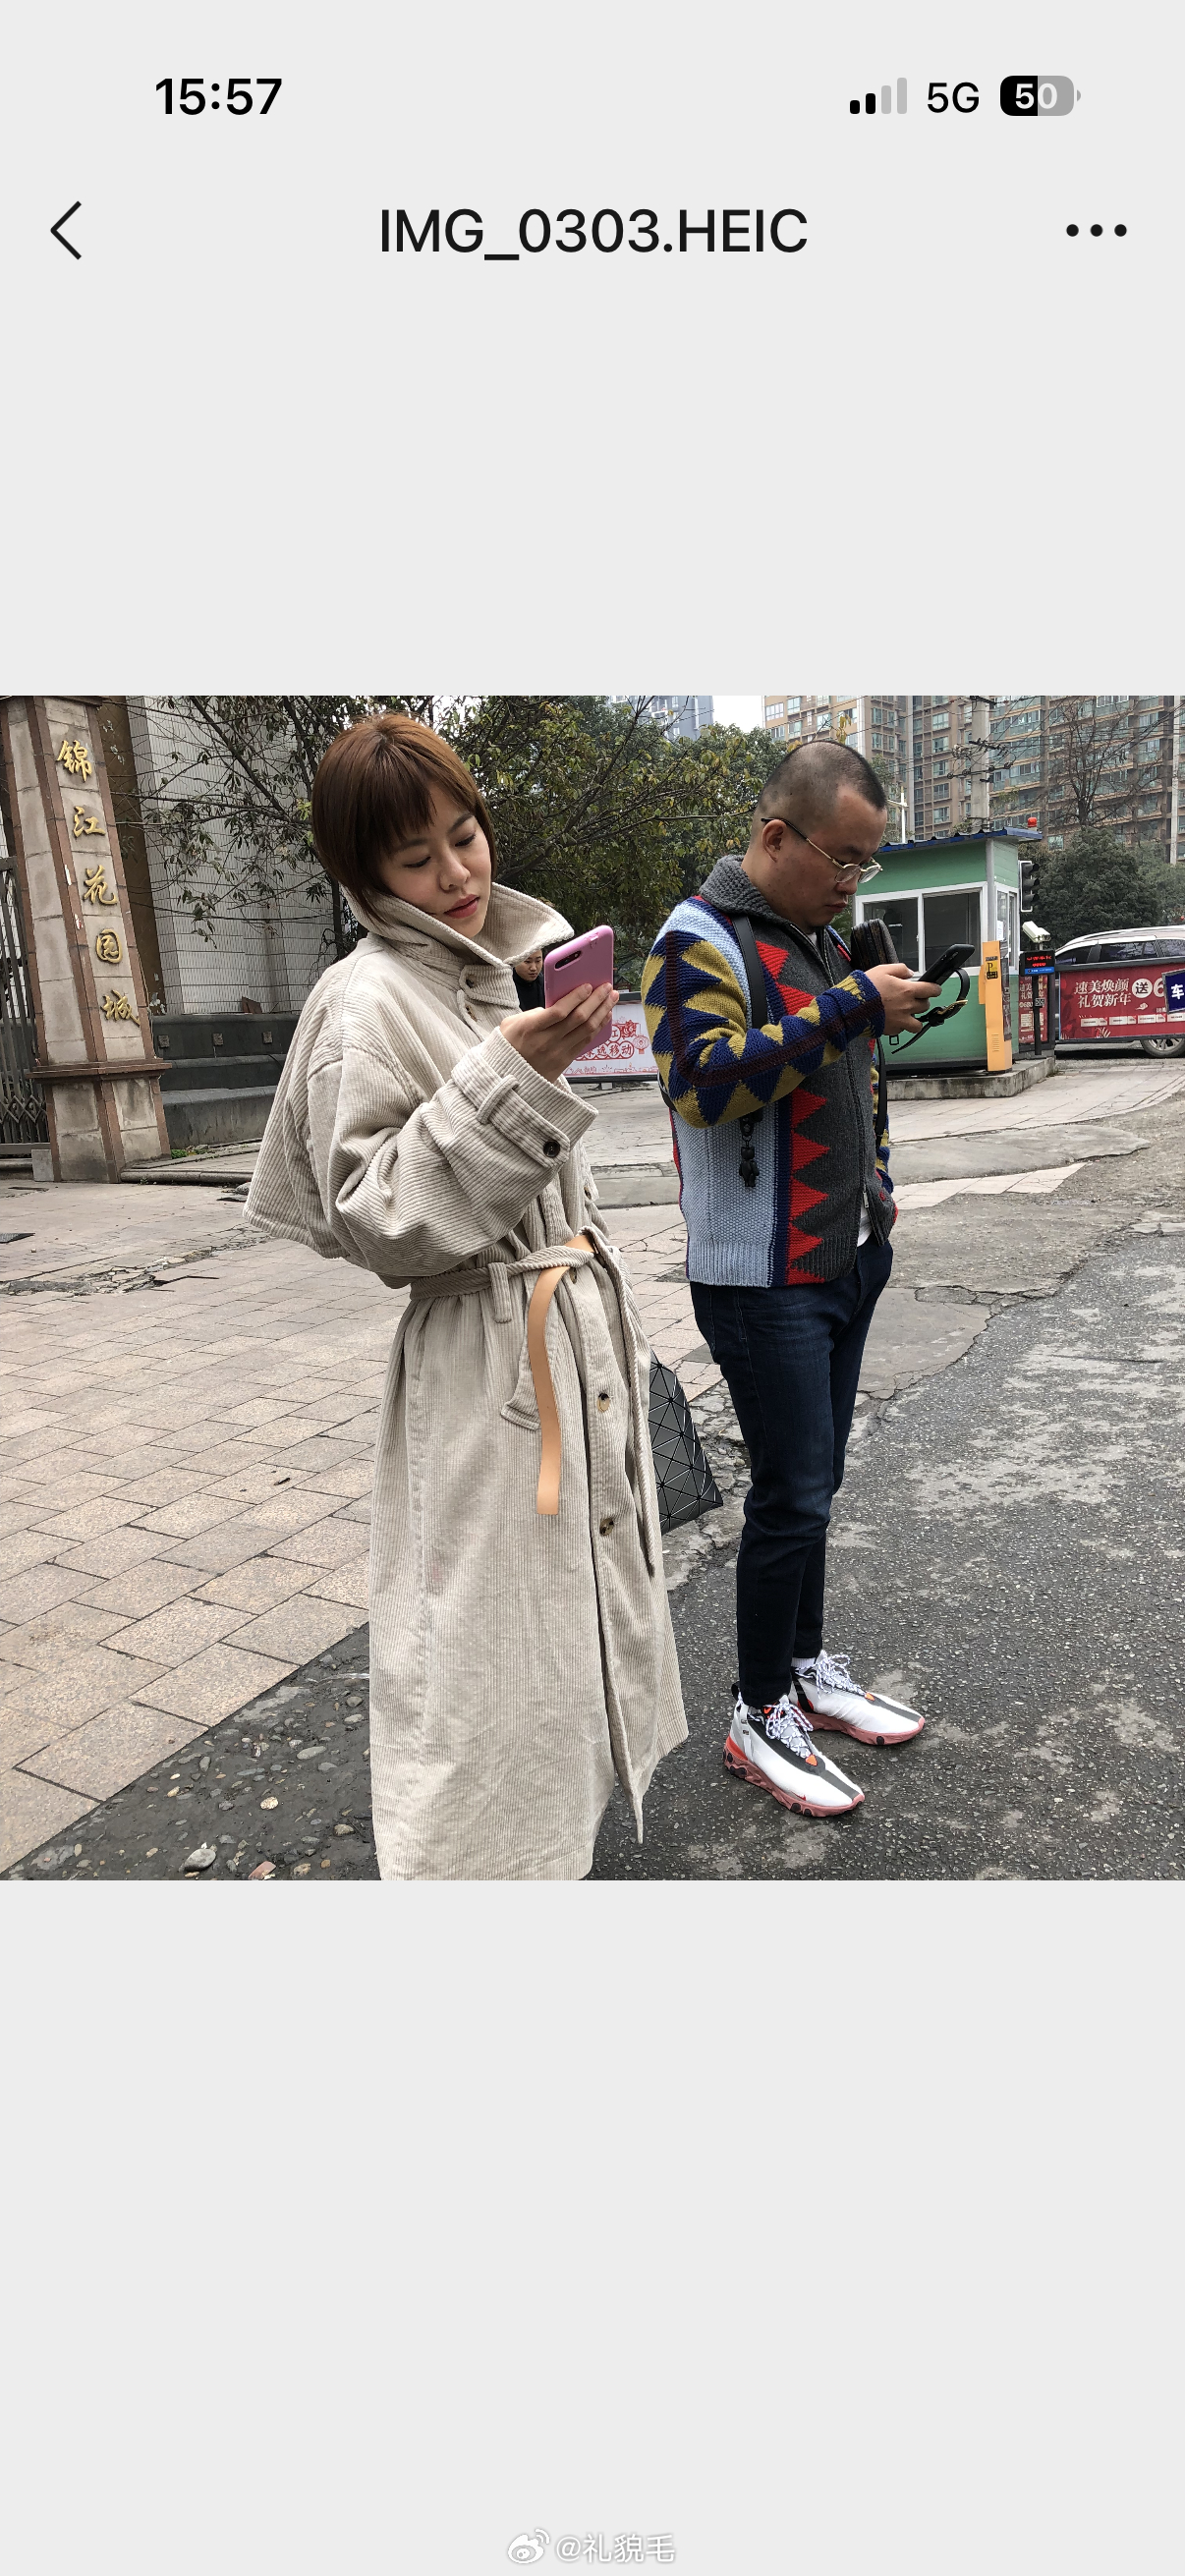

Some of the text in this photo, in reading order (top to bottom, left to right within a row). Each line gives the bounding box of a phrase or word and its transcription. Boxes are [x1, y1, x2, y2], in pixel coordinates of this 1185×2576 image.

[56, 739, 141, 1028] 锦江花园城
[1077, 992, 1132, 1009] 礼贺新年
